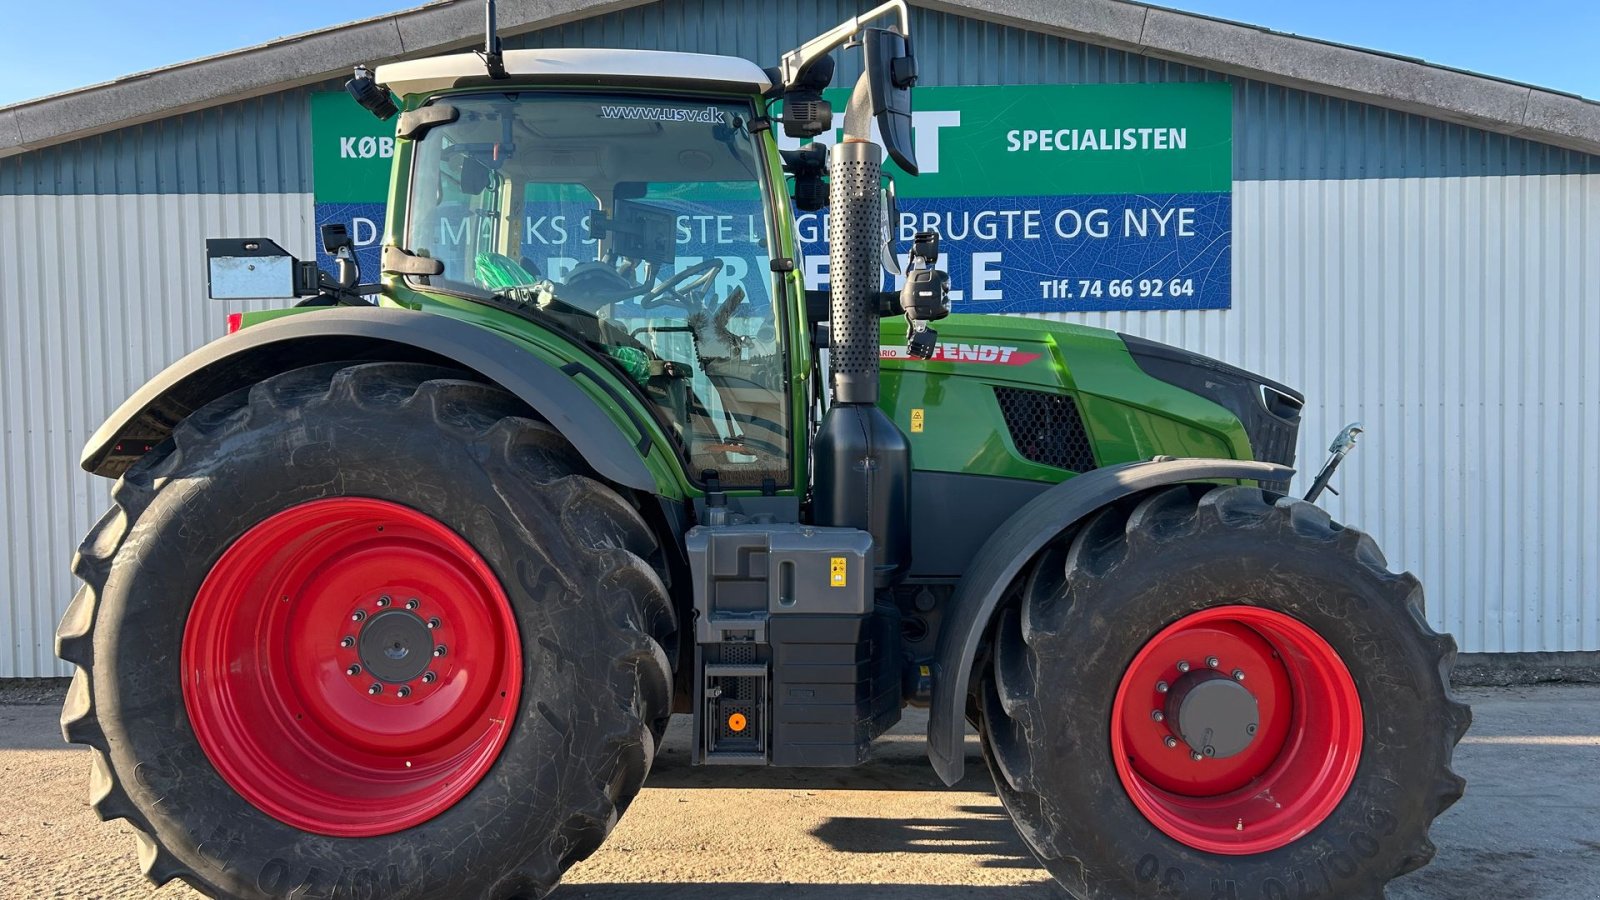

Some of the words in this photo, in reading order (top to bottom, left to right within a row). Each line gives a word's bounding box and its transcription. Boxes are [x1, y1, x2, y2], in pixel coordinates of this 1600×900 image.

[601, 104, 725, 124] www.usv.dk
[1006, 127, 1188, 152] SPECIALISTEN
[352, 215, 568, 247] DMAKS
[580, 214, 734, 245] SSTE
[899, 209, 1041, 241] BRUGTE
[1054, 208, 1110, 239] OG
[1124, 207, 1197, 238] NYE
[1040, 280, 1073, 299] Tlf.
[1078, 279, 1103, 298] 74
[1108, 279, 1134, 298] 66
[1139, 278, 1164, 297] 92
[1169, 278, 1194, 297] 64
[878, 349, 897, 358] ARIO
[931, 342, 1018, 363] FENDT
